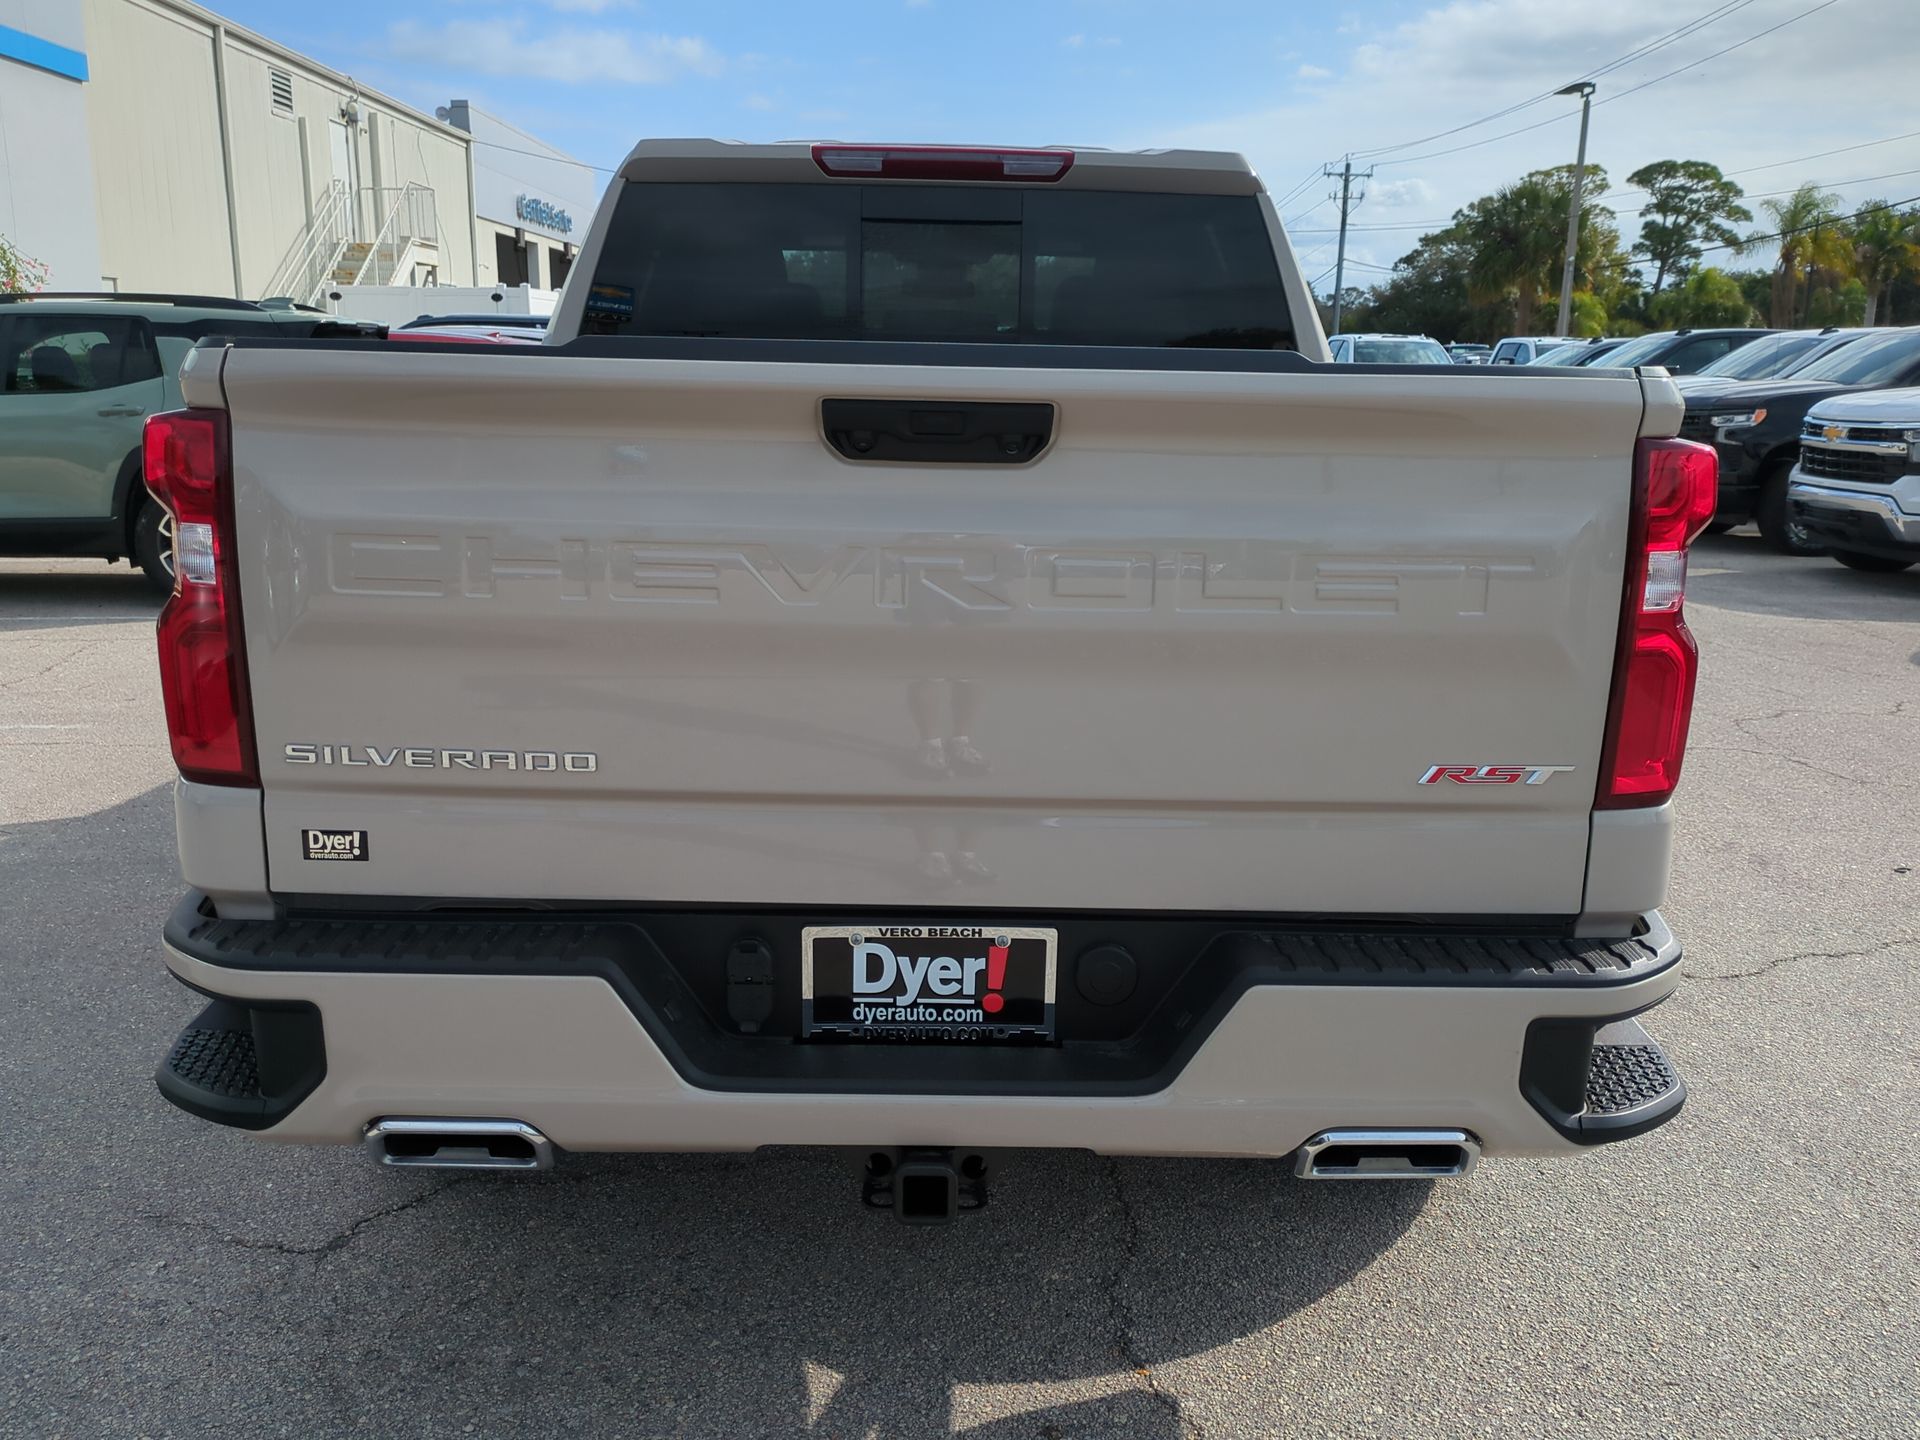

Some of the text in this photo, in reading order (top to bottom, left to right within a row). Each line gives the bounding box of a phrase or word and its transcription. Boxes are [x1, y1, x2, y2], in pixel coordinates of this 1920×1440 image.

[329, 532, 1536, 617] CHEVROLET
[284, 743, 598, 773] SILVERADO
[1417, 764, 1576, 785] RST
[308, 830, 361, 856] Dyer!
[310, 852, 354, 860] dyerauto.com
[878, 927, 983, 938] VERO BEACH
[852, 942, 1009, 1013] Dyer!
[852, 1003, 984, 1025] dyerauto.com
